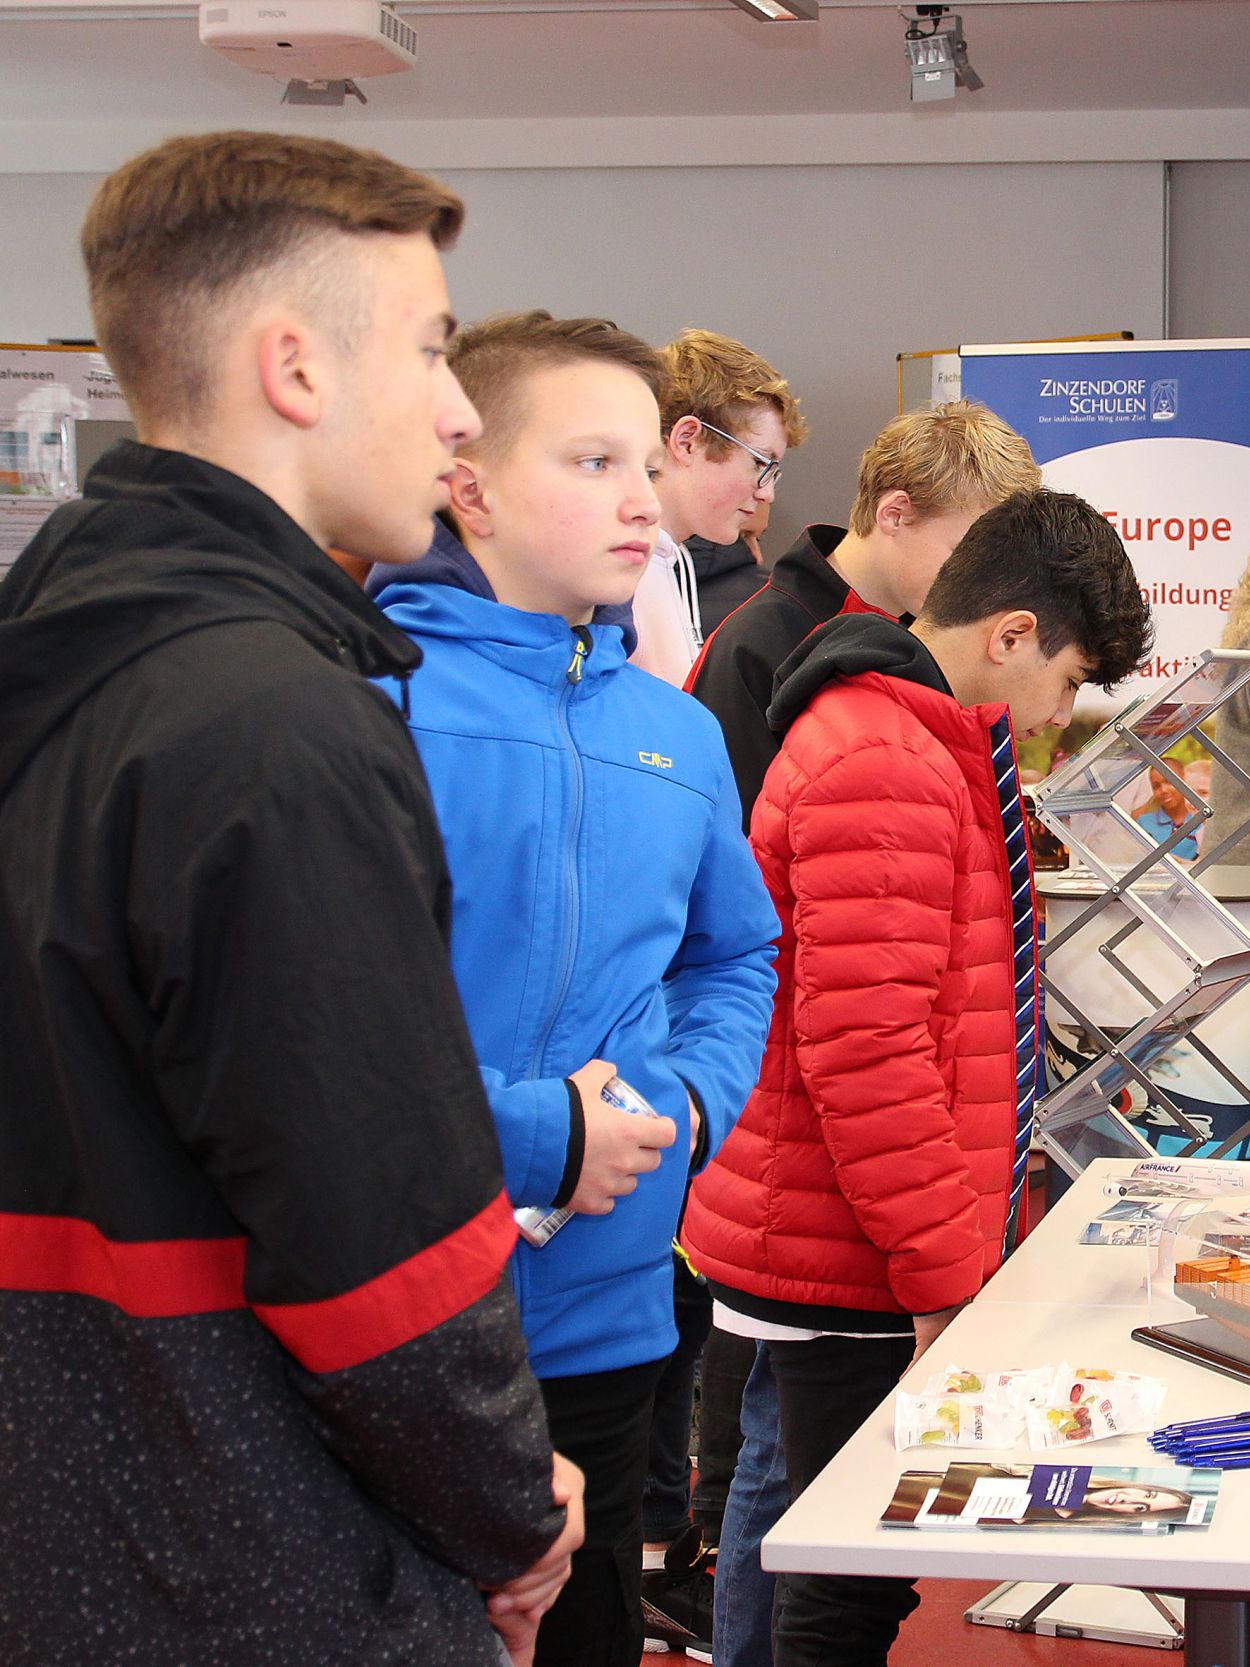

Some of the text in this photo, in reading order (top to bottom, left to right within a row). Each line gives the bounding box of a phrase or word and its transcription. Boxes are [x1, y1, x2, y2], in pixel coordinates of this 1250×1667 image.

[1040, 379, 1146, 397] ZINZENDORF
[1069, 396, 1146, 415] SCHULEN
[1038, 415, 1052, 423] Der
[1053, 414, 1095, 423] individuelle
[1097, 415, 1114, 423] Weg
[1132, 414, 1146, 422] Ziel
[1140, 1163, 1175, 1173] AIRFRANCE
